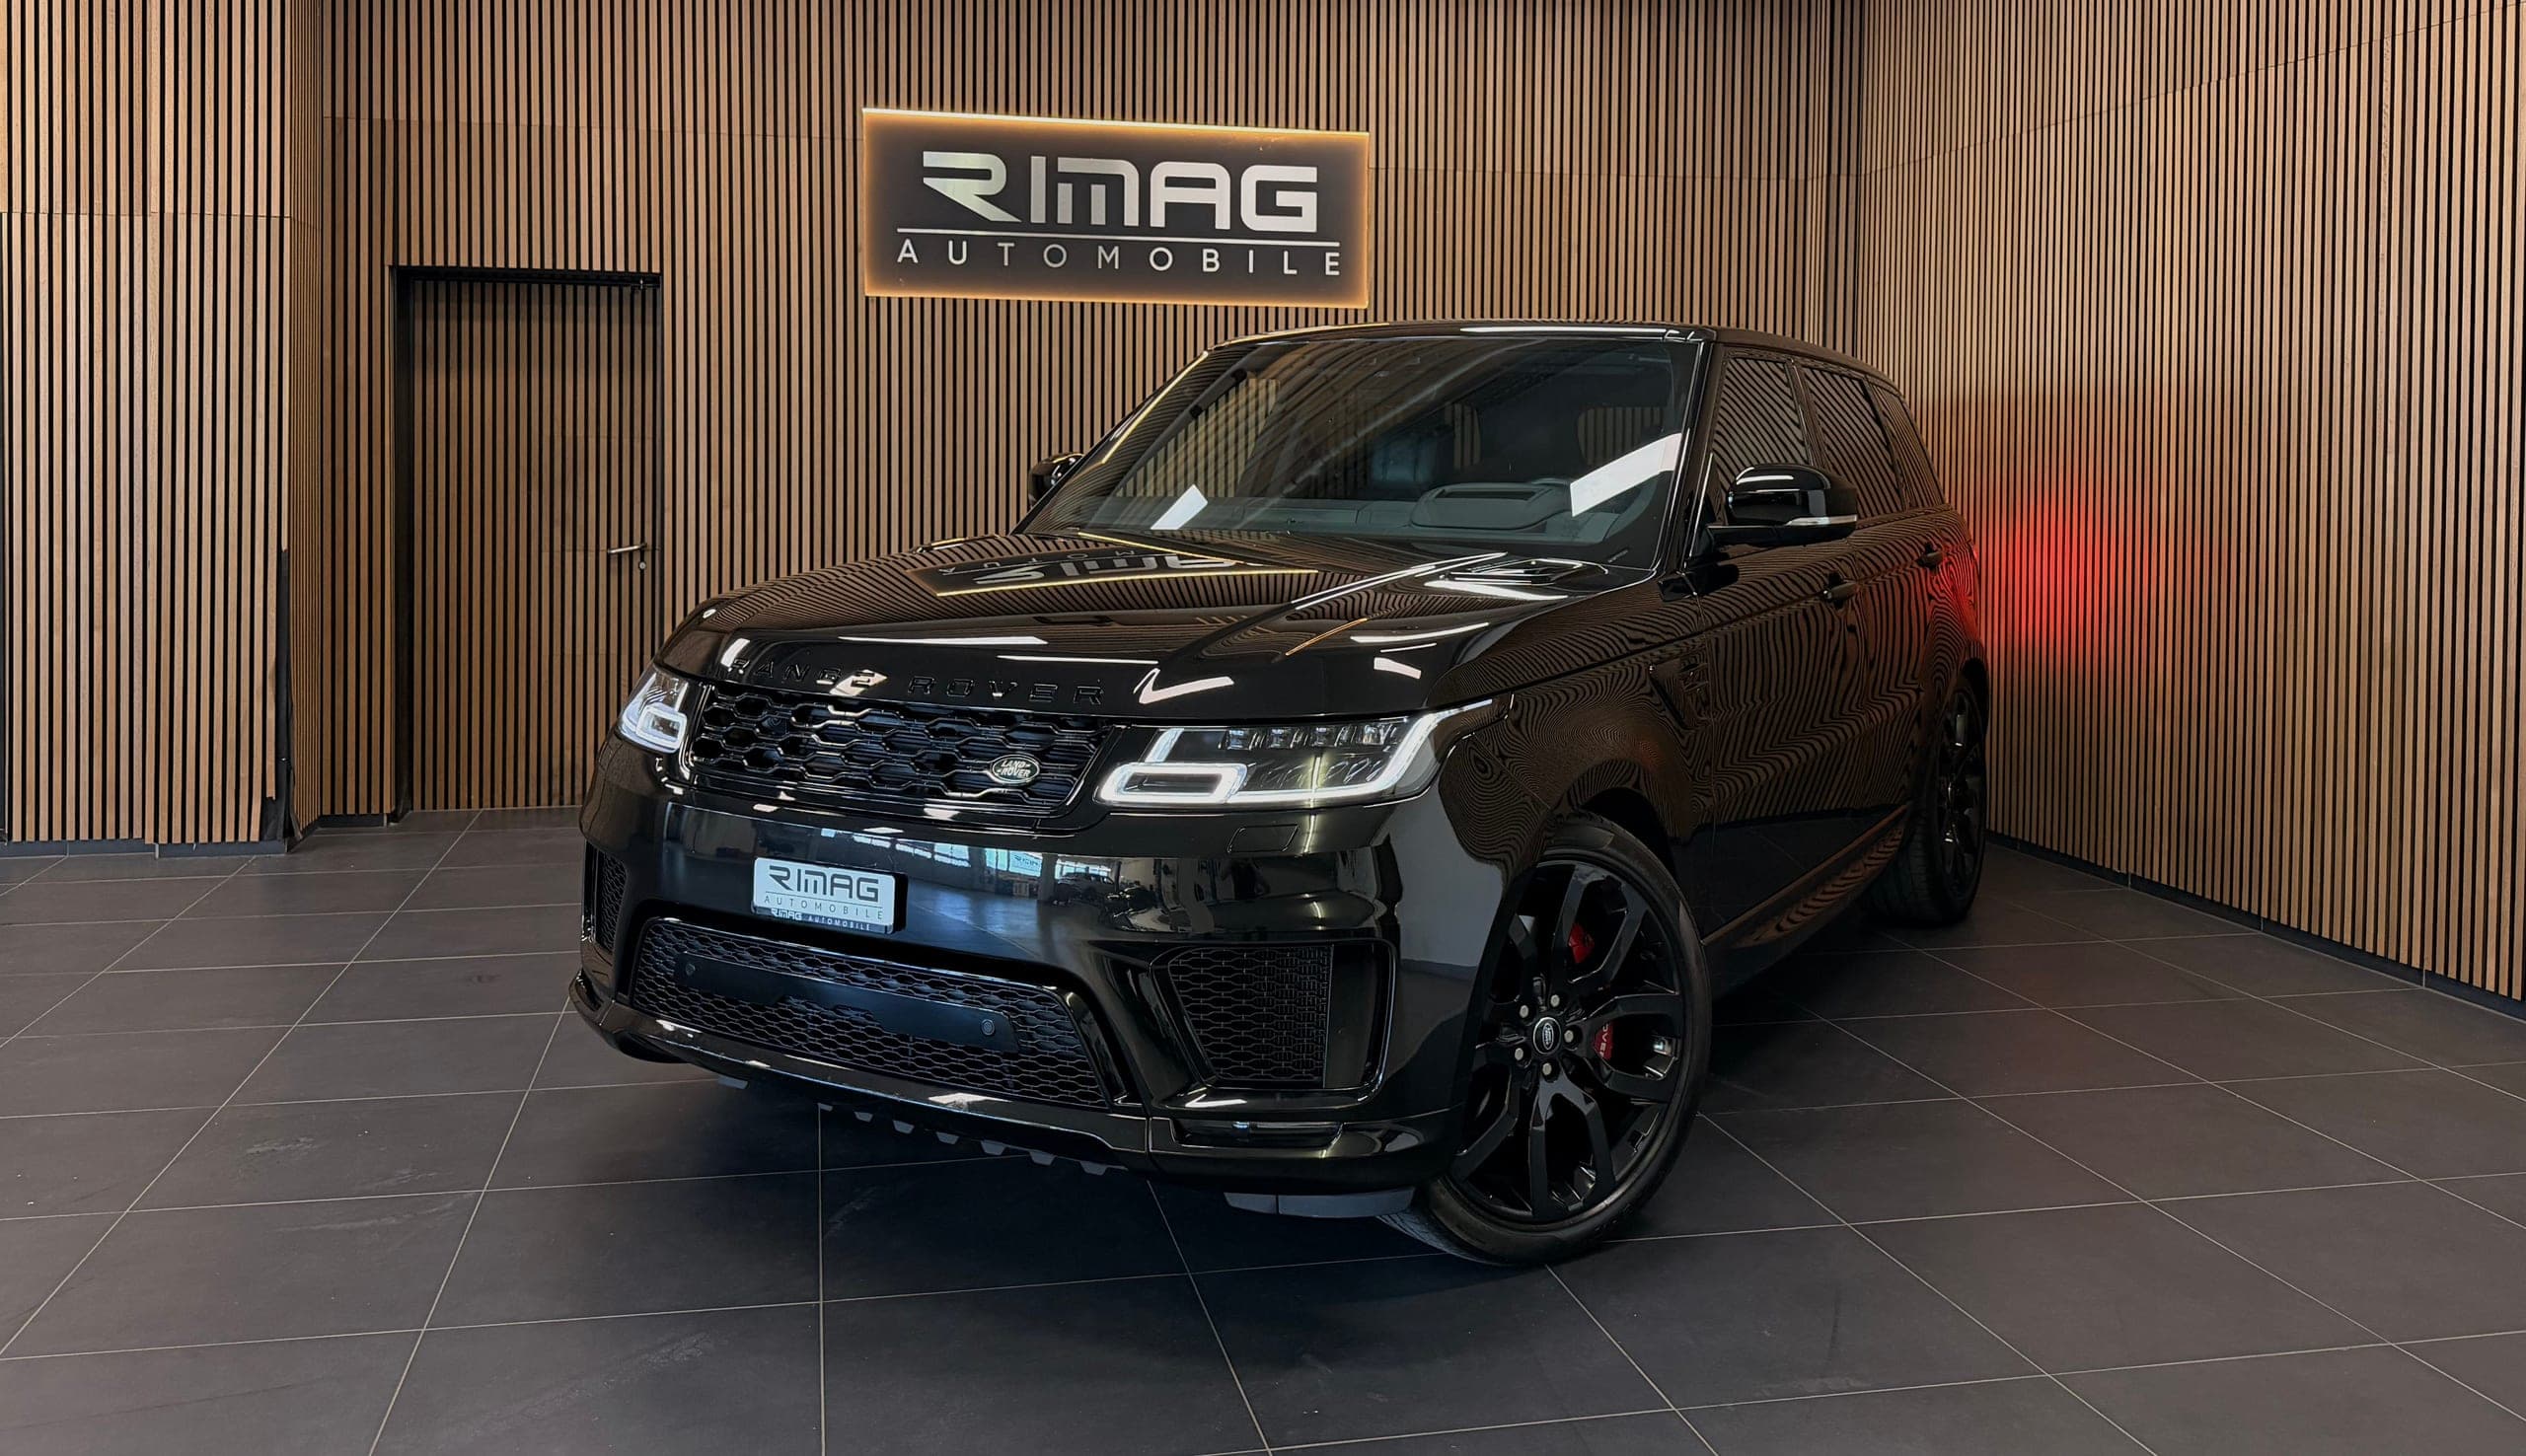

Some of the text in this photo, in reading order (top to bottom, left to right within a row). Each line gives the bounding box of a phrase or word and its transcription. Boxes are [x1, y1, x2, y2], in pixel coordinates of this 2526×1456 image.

[923, 151, 1317, 233] RIMAG
[897, 239, 1340, 276] AUTOMOBILE
[908, 675, 1104, 704] ROVER
[769, 865, 878, 903] RIMAG
[764, 895, 883, 920] AUTOMOBILE
[771, 908, 870, 931] RIMAG AUTOMOBILE
[1599, 1023, 1609, 1058] OVE
